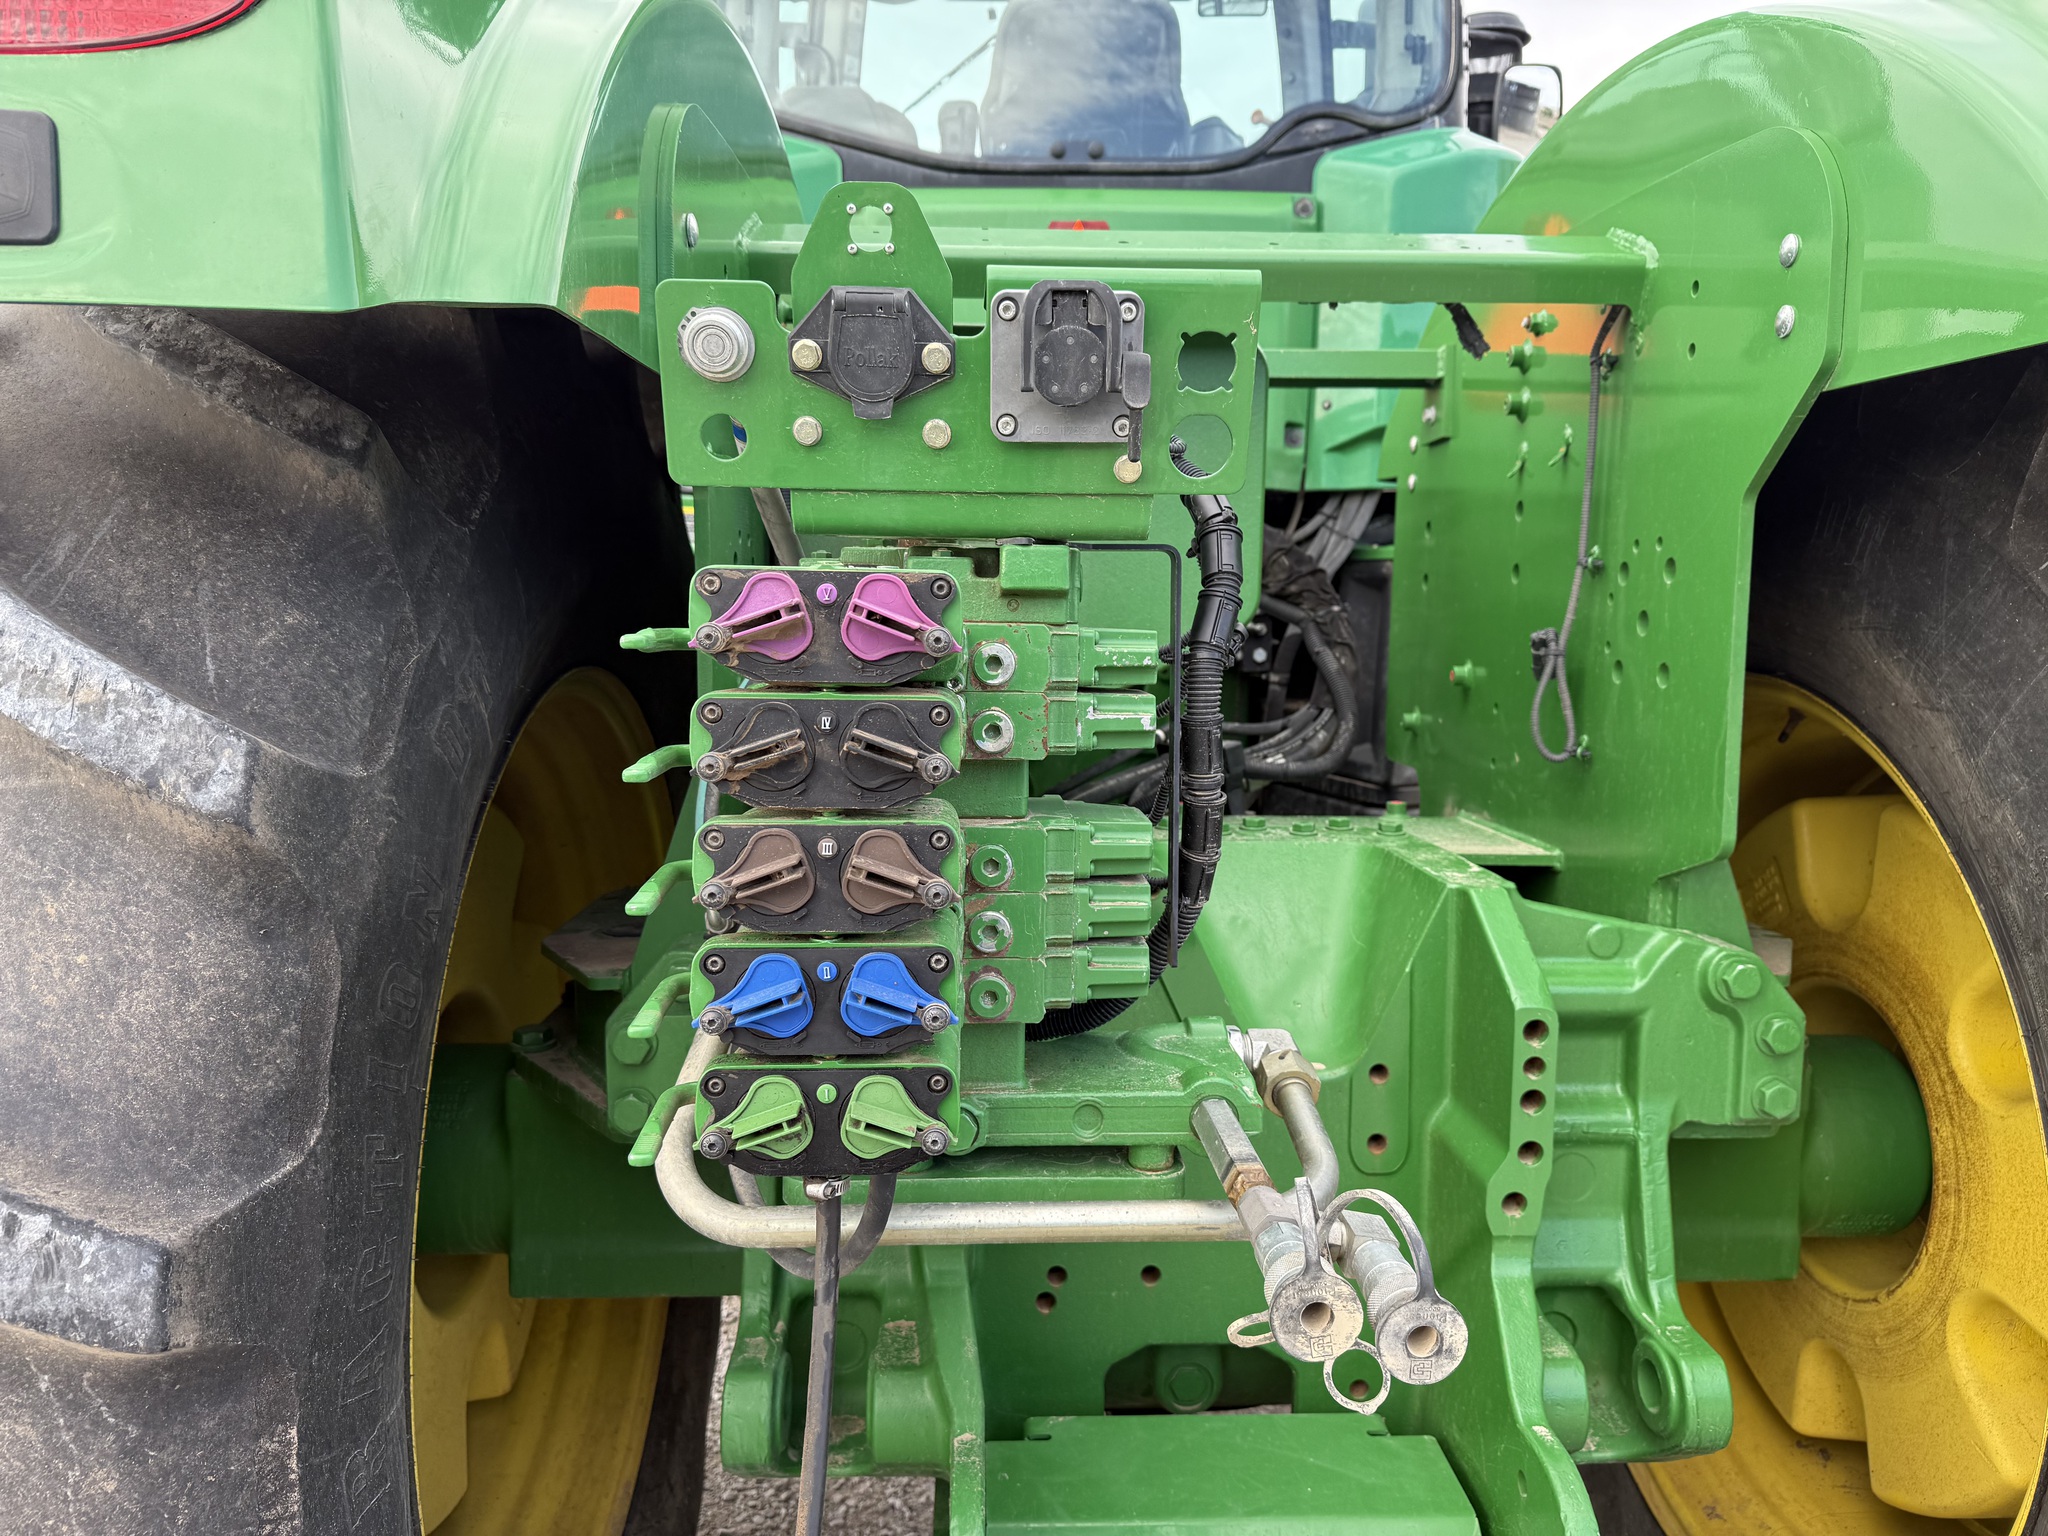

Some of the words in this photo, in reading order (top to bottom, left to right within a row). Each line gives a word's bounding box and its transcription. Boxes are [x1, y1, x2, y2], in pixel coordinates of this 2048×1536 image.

[843, 346, 900, 369] Pollak
[1031, 425, 1050, 436] ISO
[822, 587, 832, 601] V
[821, 716, 832, 730] IV
[822, 842, 833, 855] III
